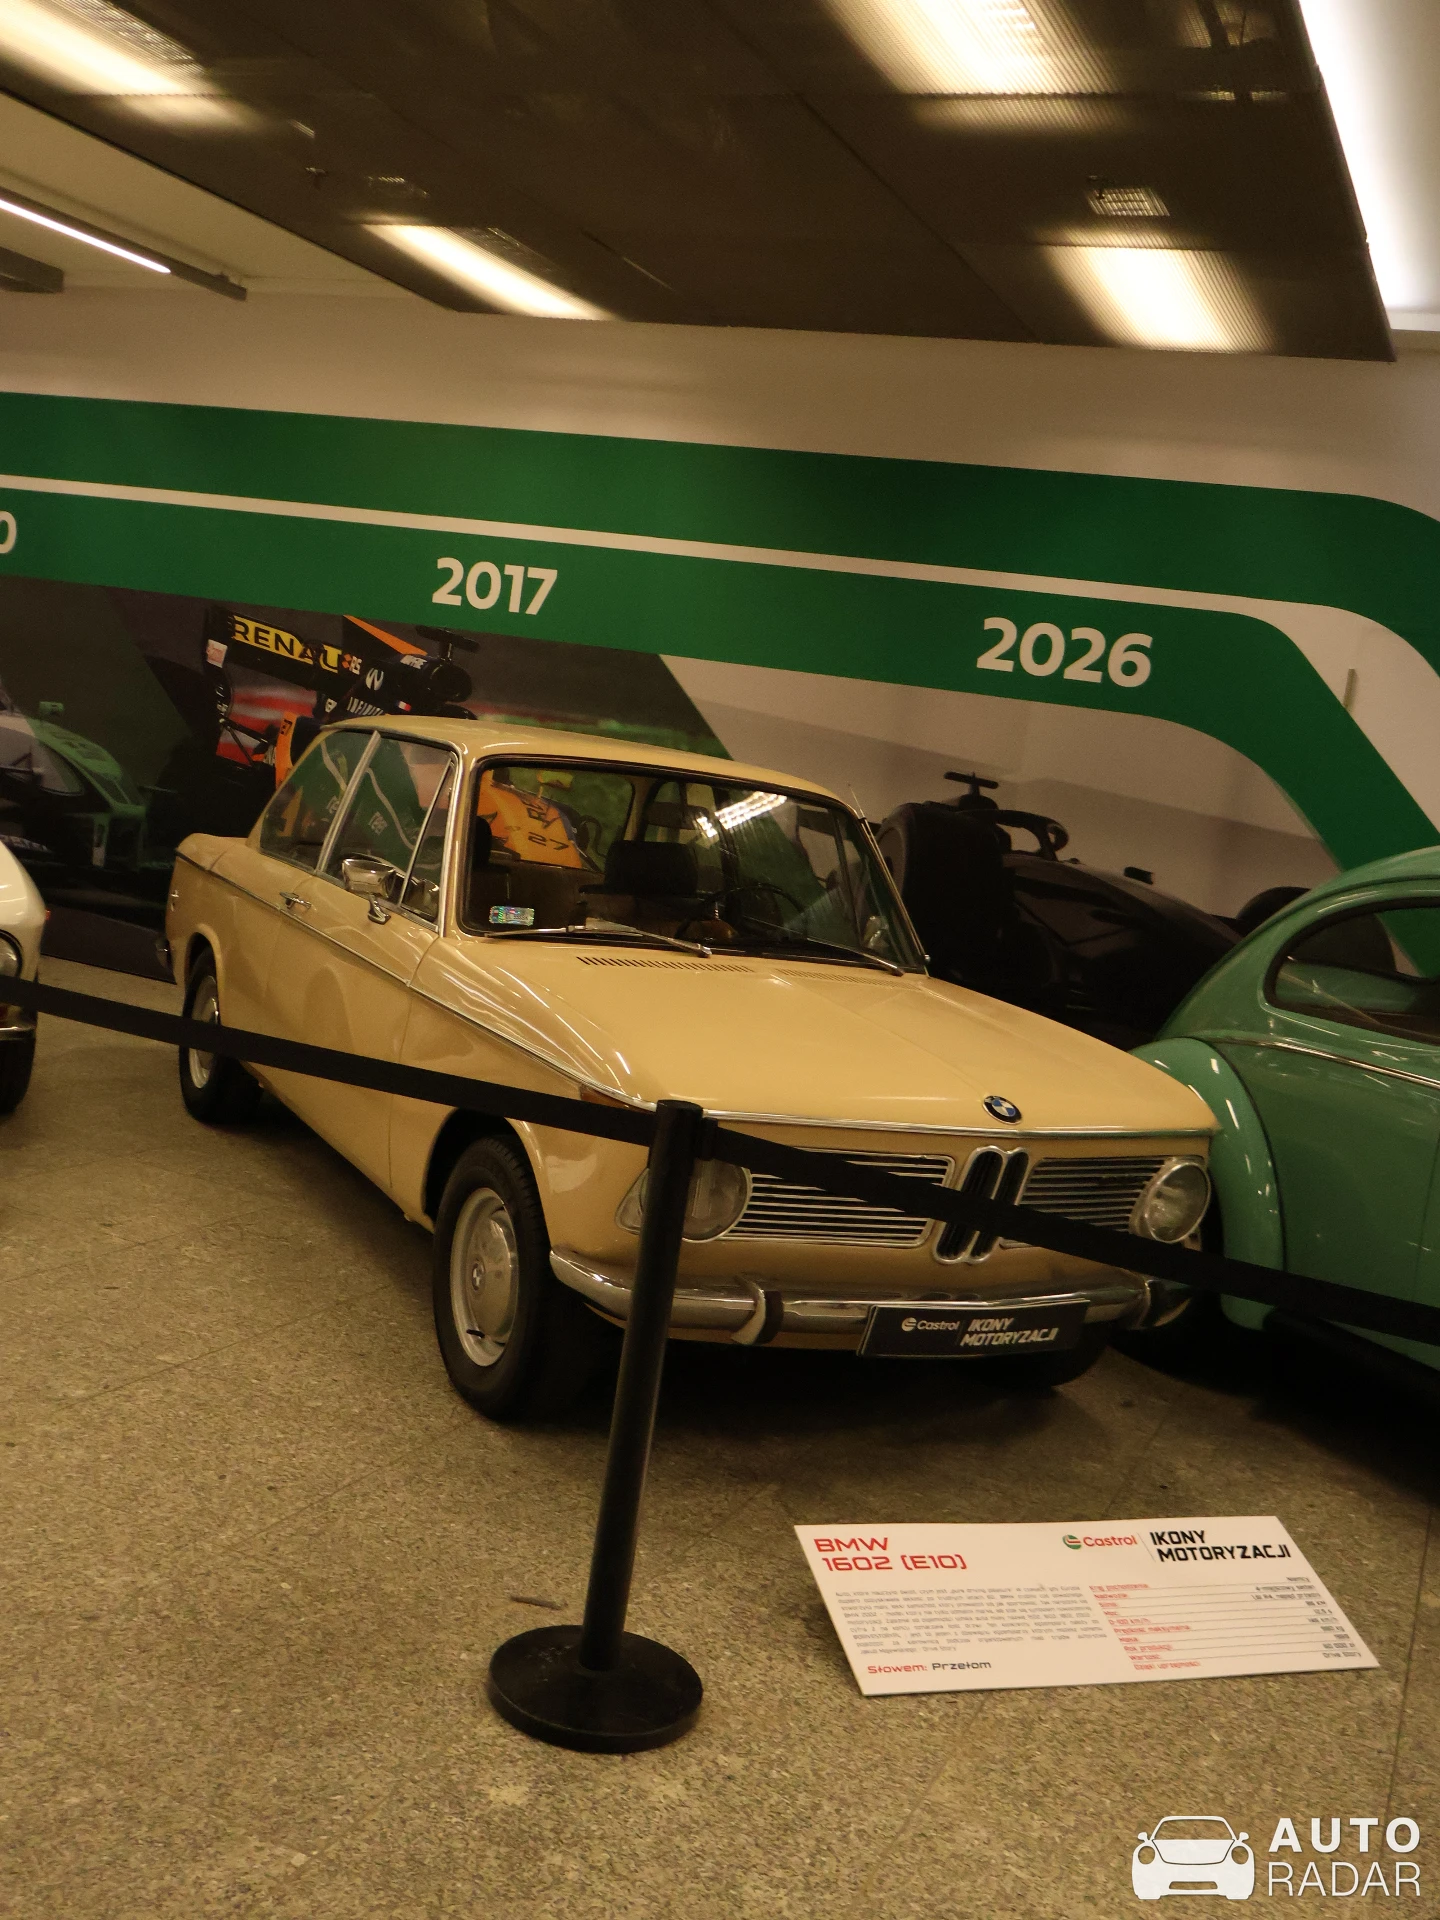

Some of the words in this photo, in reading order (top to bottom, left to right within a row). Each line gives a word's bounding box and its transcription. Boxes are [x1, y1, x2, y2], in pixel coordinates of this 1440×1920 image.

[432, 557, 558, 616] 2017
[976, 617, 1153, 688] 2026
[917, 1320, 960, 1330] Castrol
[967, 1318, 1014, 1331] IKONY
[960, 1328, 1059, 1346] MOTORYZACJI
[814, 1537, 888, 1552] BMW
[1083, 1534, 1138, 1547] Castrol
[1149, 1530, 1206, 1545] IKONY
[1157, 1544, 1292, 1562] MOTORYZACJI
[822, 1556, 893, 1571] 1602
